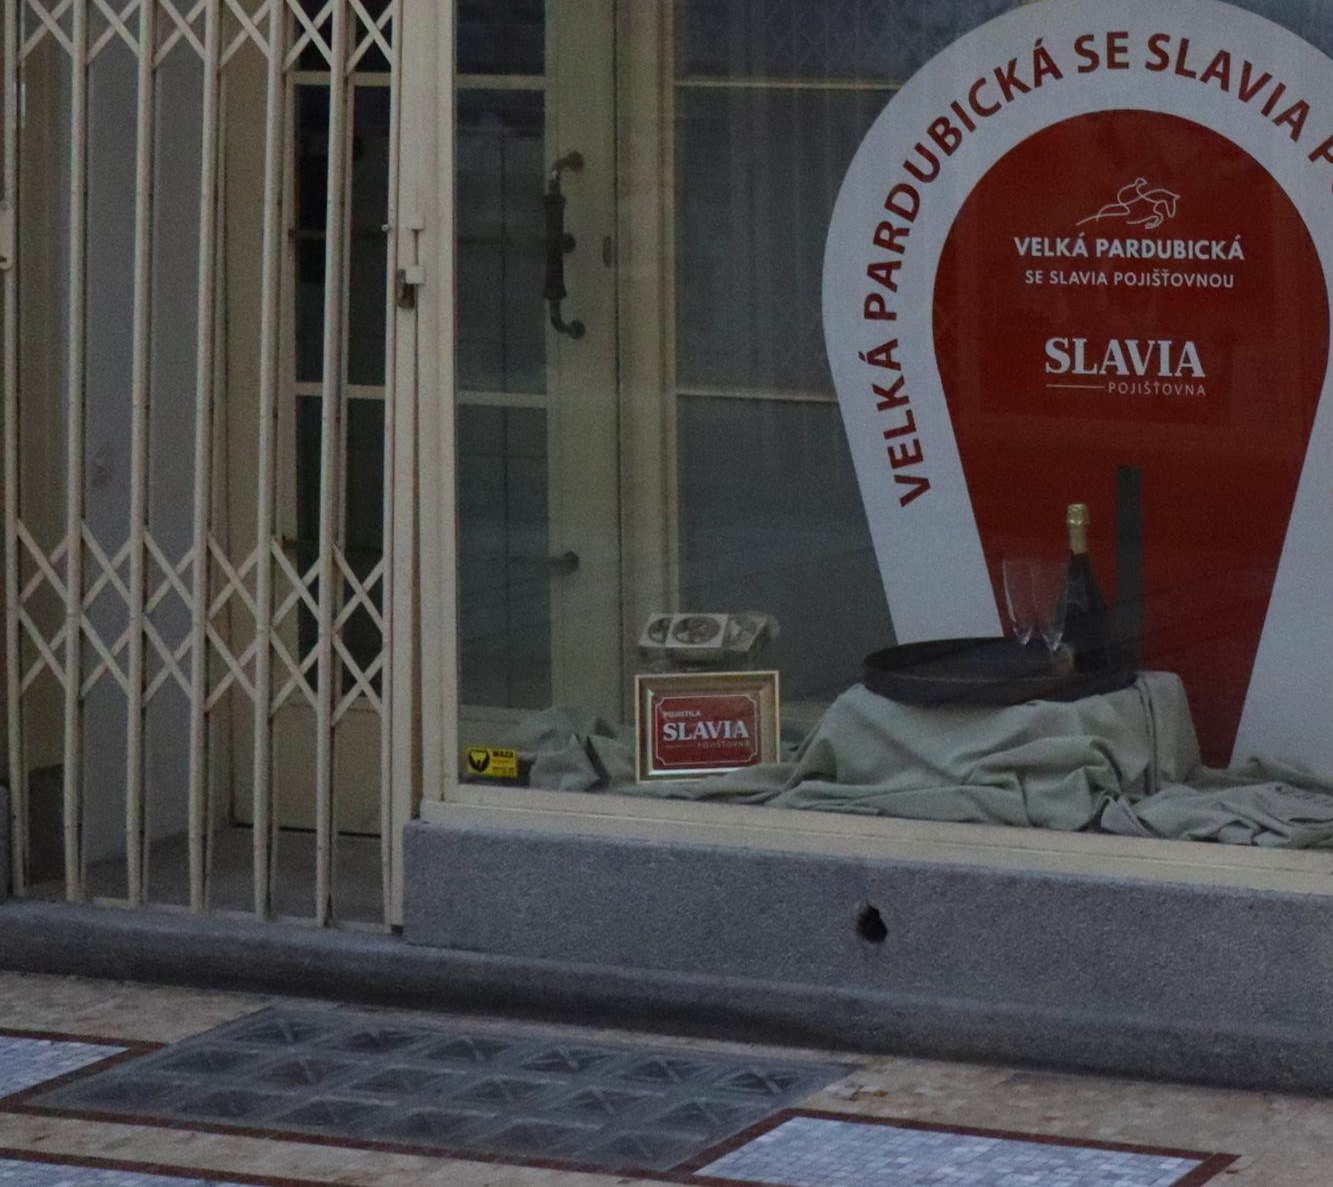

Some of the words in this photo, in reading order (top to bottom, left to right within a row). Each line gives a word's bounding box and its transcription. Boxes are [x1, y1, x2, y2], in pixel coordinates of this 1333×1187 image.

[1074, 31, 1130, 74] SE
[1144, 32, 1313, 142] SLAVIA
[863, 38, 1064, 322] PARDUBICKÁ
[1014, 232, 1089, 257] VELKÁ
[1096, 234, 1245, 260] PARDUBICKÁ
[1025, 270, 1043, 284] SE
[1050, 271, 1108, 286] SLAVIA
[1114, 269, 1234, 288] POJIŠŤOVNOU
[1044, 337, 1206, 378] SLAVIA
[1108, 380, 1206, 396] POJIŠŤOVNA
[857, 339, 931, 509] VELKÁ
[663, 719, 750, 741] SLAVIA
